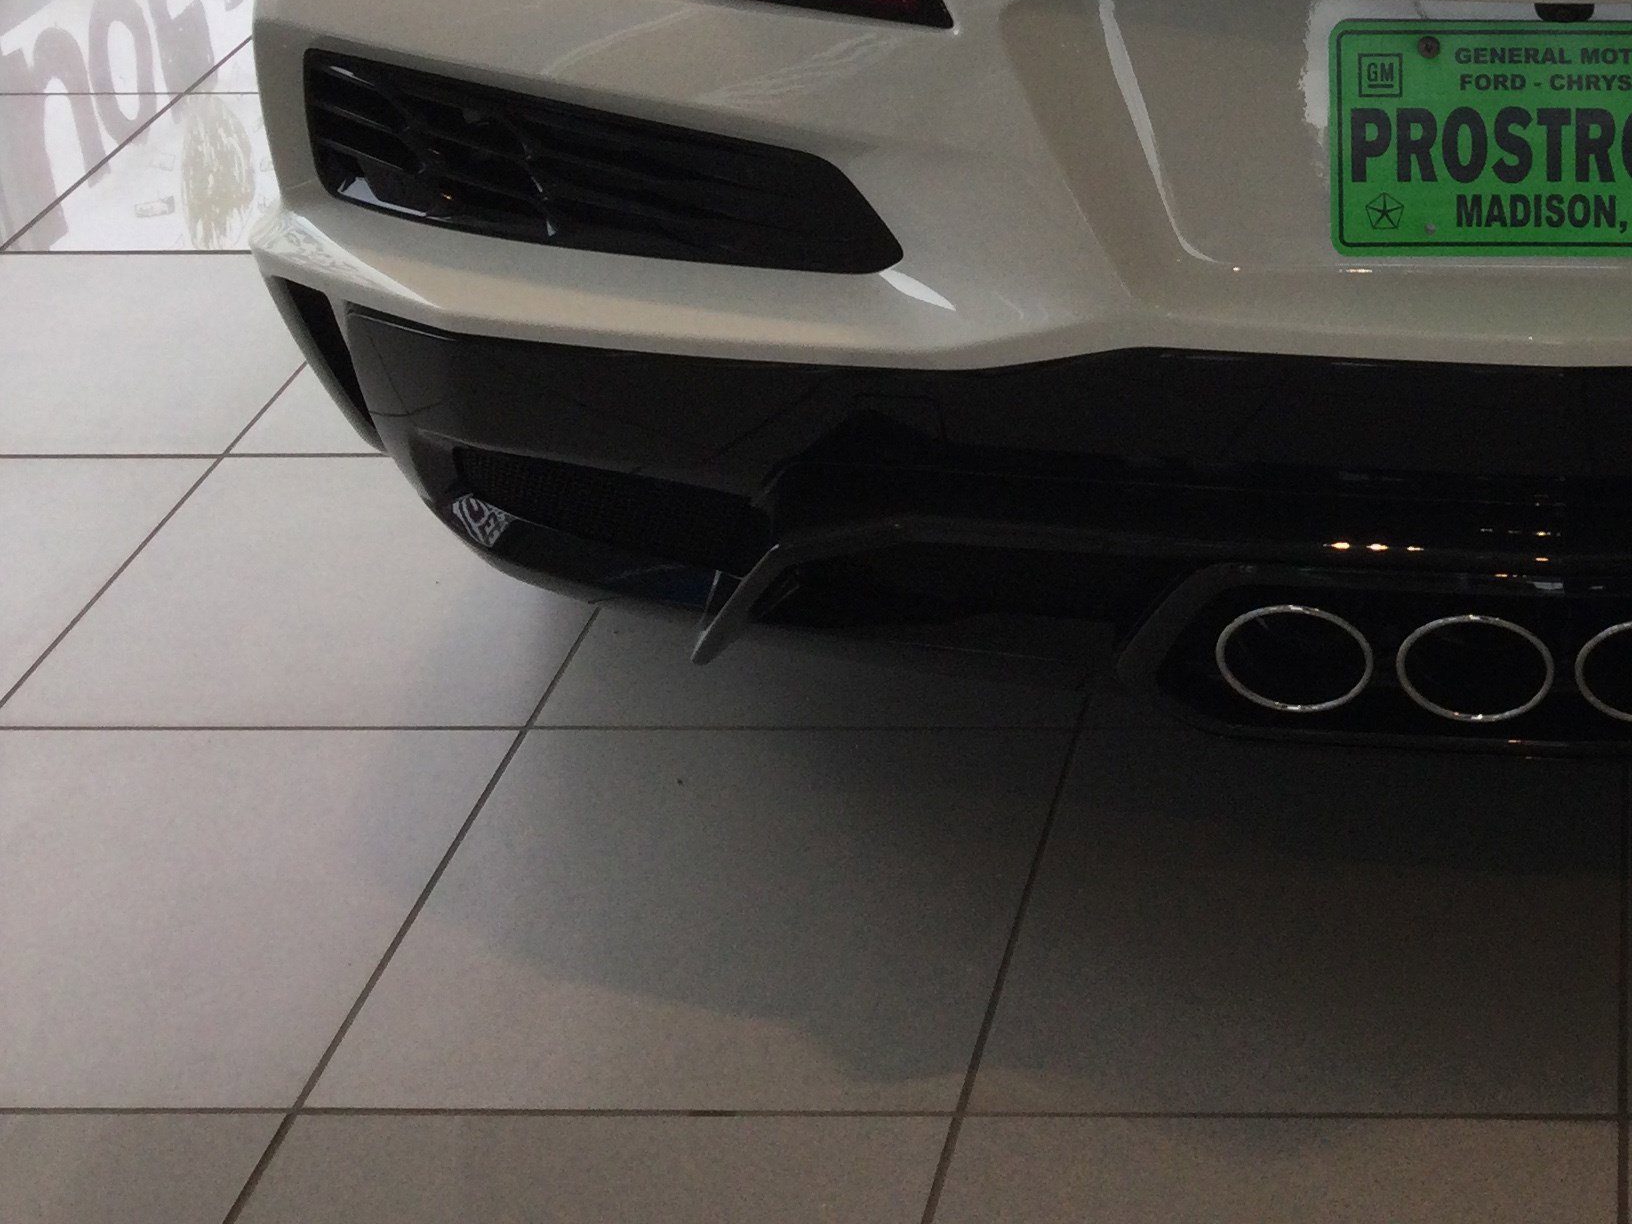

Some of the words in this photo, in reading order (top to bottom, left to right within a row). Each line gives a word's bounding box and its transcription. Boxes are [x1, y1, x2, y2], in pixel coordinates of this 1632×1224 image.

[1454, 46, 1572, 66] GENERAL
[1366, 64, 1395, 82] GM
[1458, 73, 1527, 92] FORD
[1455, 193, 1628, 234] MADISON,
